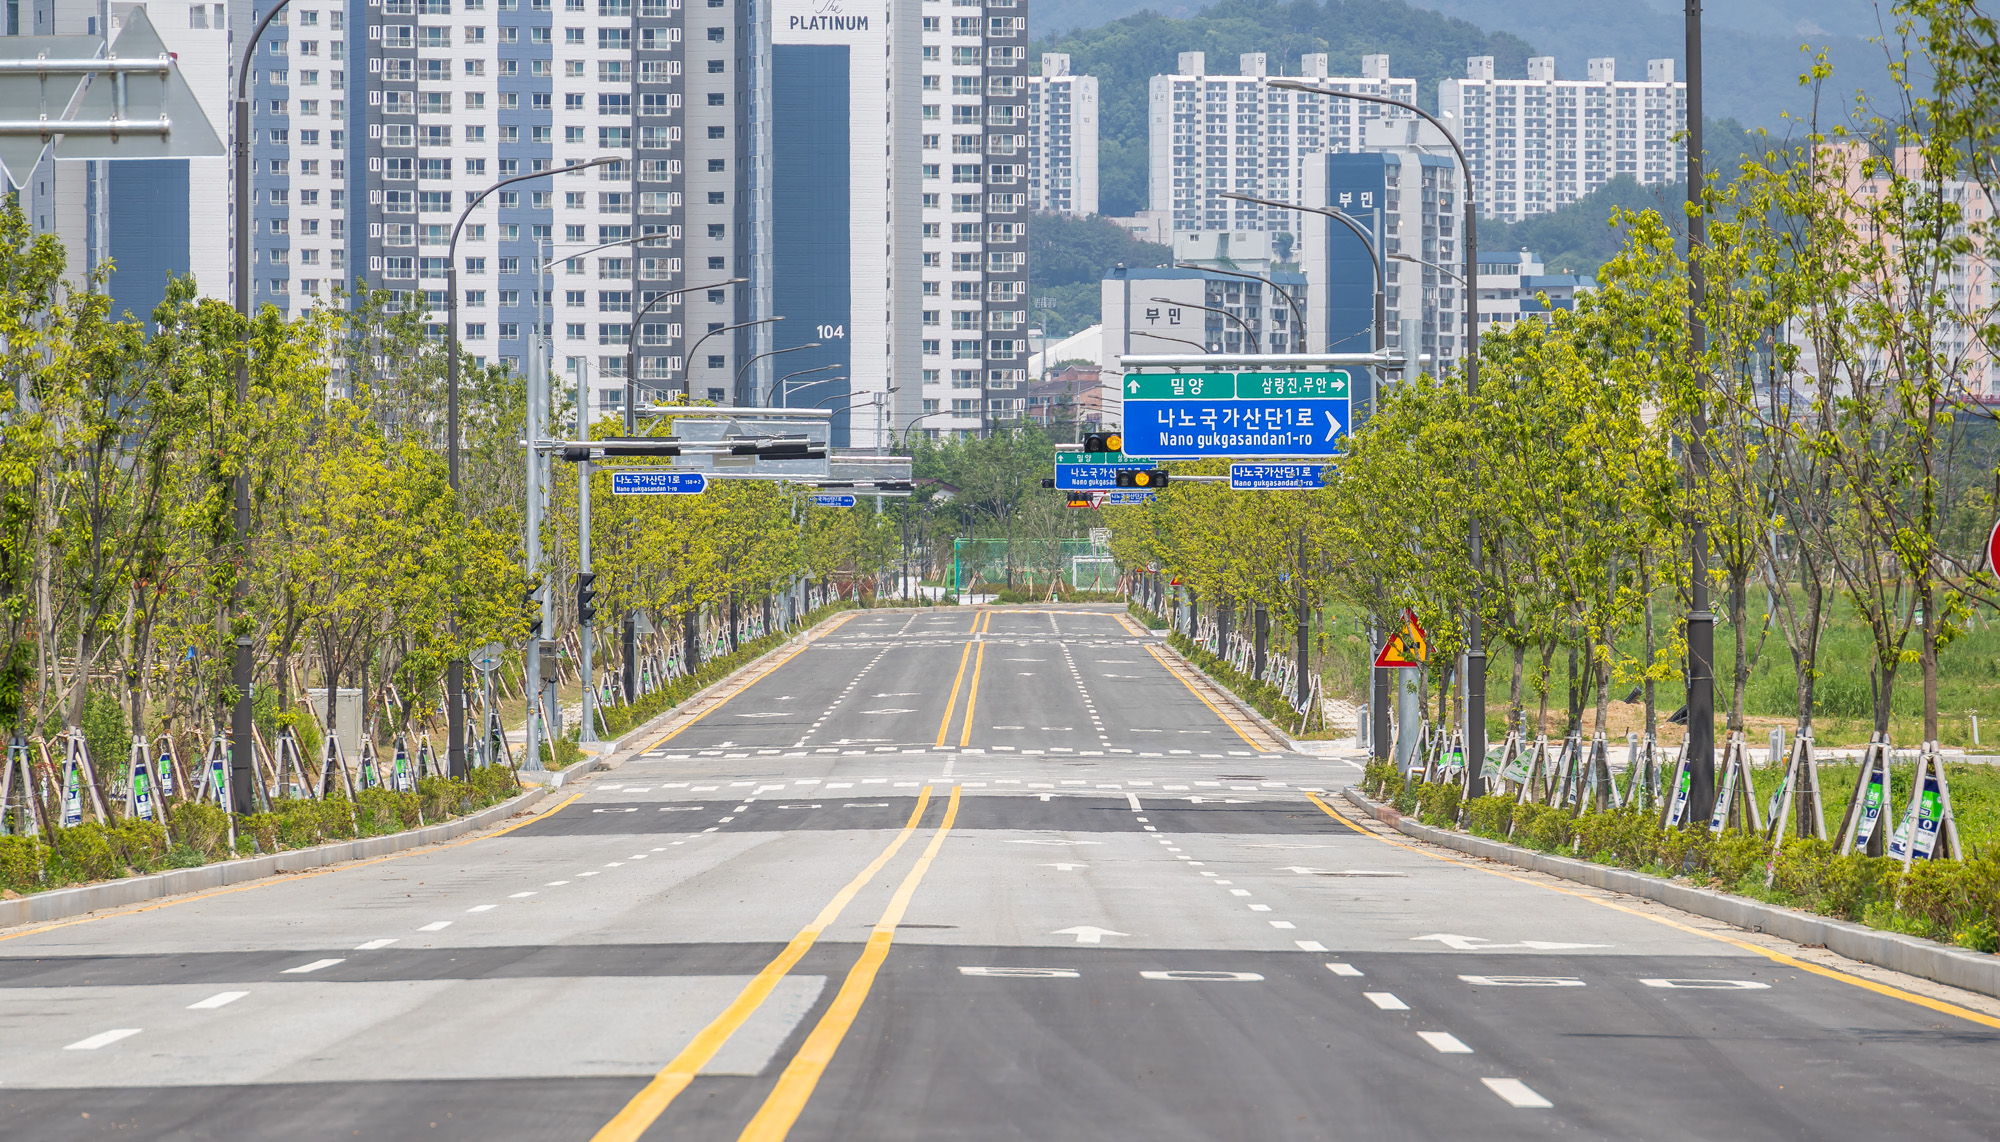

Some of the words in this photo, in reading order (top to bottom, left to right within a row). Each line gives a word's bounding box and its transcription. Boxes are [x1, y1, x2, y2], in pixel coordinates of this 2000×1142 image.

[790, 15, 869, 31] PLATINUM
[1338, 192, 1374, 208] 부민
[1145, 306, 1182, 326] 부민
[816, 325, 845, 339] 104
[1170, 378, 1204, 395] 밀양
[1262, 377, 1327, 394] 삼랑진,무안
[1158, 408, 1314, 430] 나노국가산단1로
[1160, 432, 1194, 446] Nano
[1198, 432, 1312, 448] gukgasandan1-ro
[1076, 454, 1092, 462] 밀양
[1234, 466, 1312, 478] 나노국가산단1로
